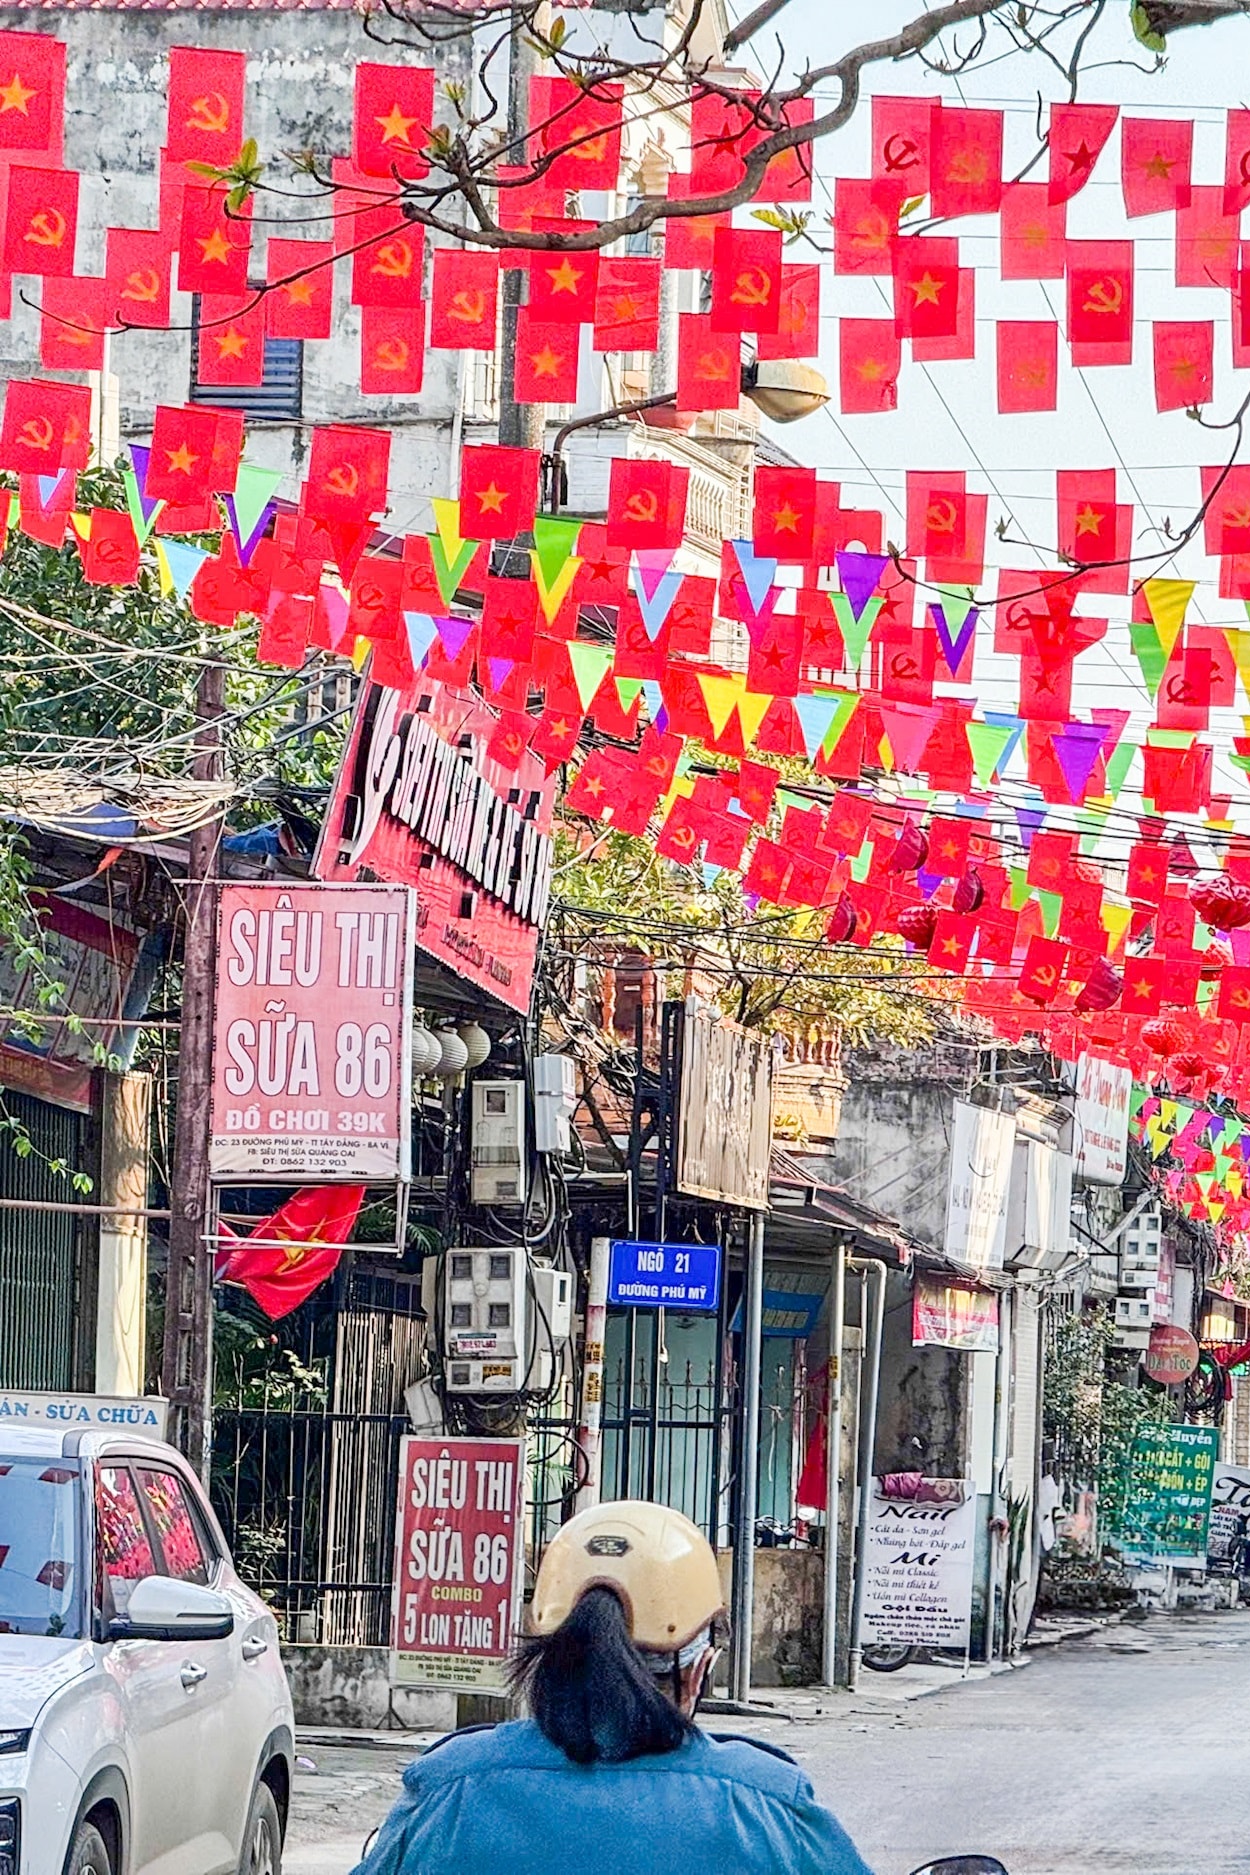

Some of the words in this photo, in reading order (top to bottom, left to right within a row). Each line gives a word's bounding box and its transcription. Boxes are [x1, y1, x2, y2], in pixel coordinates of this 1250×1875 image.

[228, 894, 321, 988] SIÊU
[335, 911, 400, 1006] THỊ
[224, 1000, 320, 1097] SỮA
[335, 1022, 391, 1099] 86
[226, 1103, 261, 1131] ĐỒ
[269, 1108, 329, 1132] CHƠI
[337, 1111, 387, 1133] 39K
[638, 1248, 664, 1272] NGÕ
[674, 1253, 690, 1274] 21
[618, 1281, 659, 1297] ĐƯỜNG
[661, 1284, 685, 1299] PHÚ
[688, 1285, 707, 1300] MỸ
[46, 1400, 91, 1421] SỬA
[97, 1404, 158, 1425] CHỮA
[411, 1448, 468, 1509] SIÊU
[475, 1460, 513, 1523] THỊ
[878, 1505, 957, 1521] Nail
[408, 1517, 464, 1582] SỮA
[473, 1533, 508, 1585] 86
[431, 1585, 483, 1602] COMBO
[404, 1593, 417, 1644] 5
[421, 1613, 450, 1646] LON
[454, 1609, 493, 1654] TẶNG
[498, 1598, 507, 1650] 1
